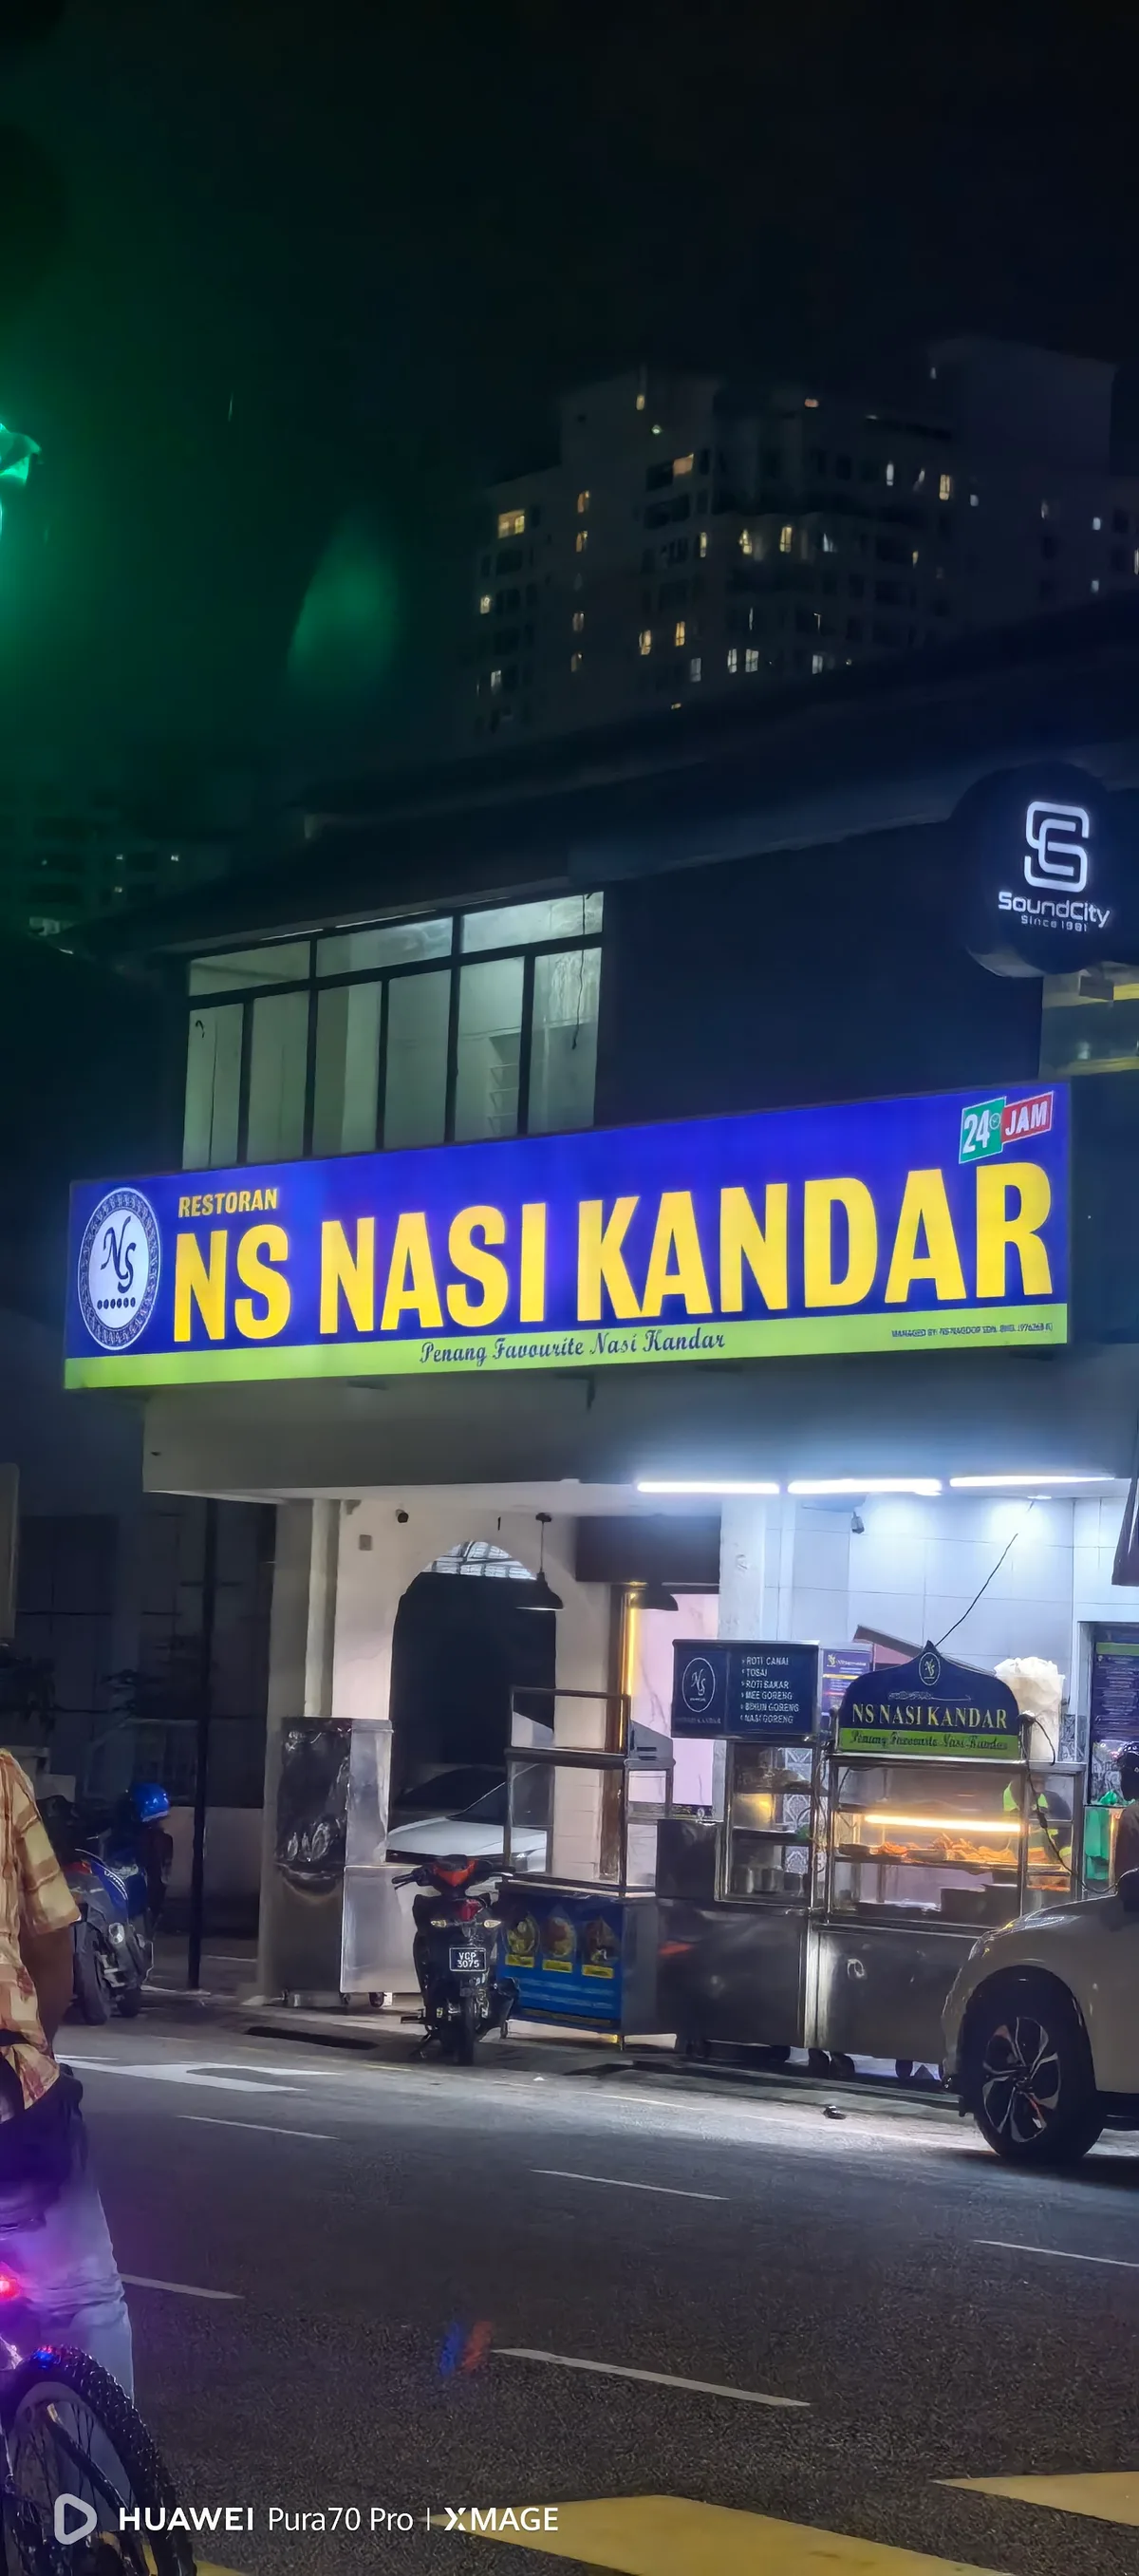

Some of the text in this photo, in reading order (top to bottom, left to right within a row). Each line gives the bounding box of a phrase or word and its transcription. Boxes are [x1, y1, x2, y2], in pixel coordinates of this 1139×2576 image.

[999, 892, 1110, 928] SoundCity
[1021, 914, 1056, 928] Since
[962, 1101, 1048, 1154] 24 JAM
[178, 1188, 277, 1218] RESTORAN
[174, 1161, 1054, 1342] NS NASI KANDAR
[420, 1327, 725, 1366] Penang Favourite Nasi Kandar
[746, 1656, 763, 1665] ROTI
[745, 1680, 763, 1689] ROTI
[761, 1691, 794, 1701] GORENG
[762, 1714, 794, 1723] GORENG
[852, 1703, 1007, 1729] NS NASI KANDAR
[457, 1959, 479, 1968] 3075
